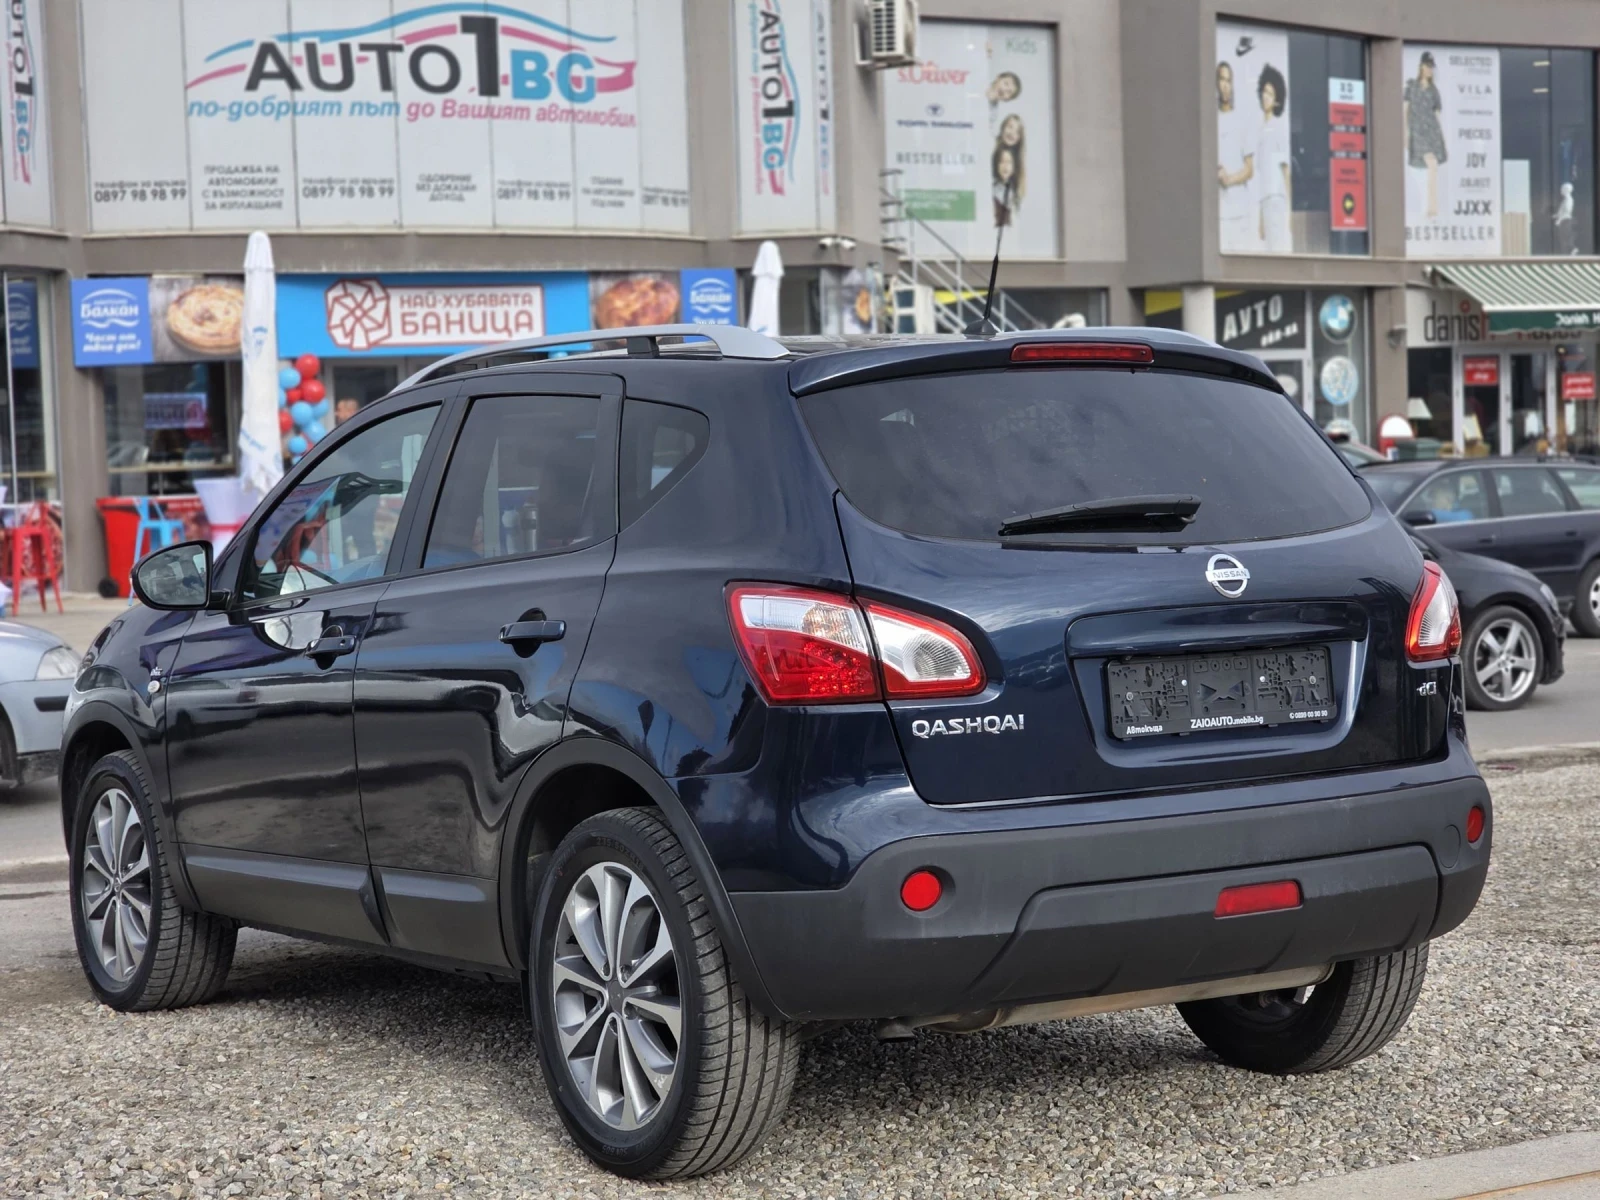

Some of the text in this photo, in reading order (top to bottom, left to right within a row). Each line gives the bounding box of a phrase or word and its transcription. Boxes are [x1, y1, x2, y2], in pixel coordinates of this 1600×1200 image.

[188, 95, 343, 122] по-добрият
[349, 101, 401, 117] път
[406, 102, 435, 122] до
[94, 187, 187, 203] 0897 98 98 99
[302, 186, 394, 199] 0897 98 98 99
[1454, 199, 1492, 216] JJXX
[1405, 226, 1496, 241] BESTSELLER
[400, 291, 533, 308] НАЙ-ХУБАВАТА
[400, 310, 533, 338] БАНИЦА
[1212, 570, 1247, 579] NISSAN
[911, 714, 1025, 739] QASHQAI
[1126, 724, 1163, 735] Автокъща
